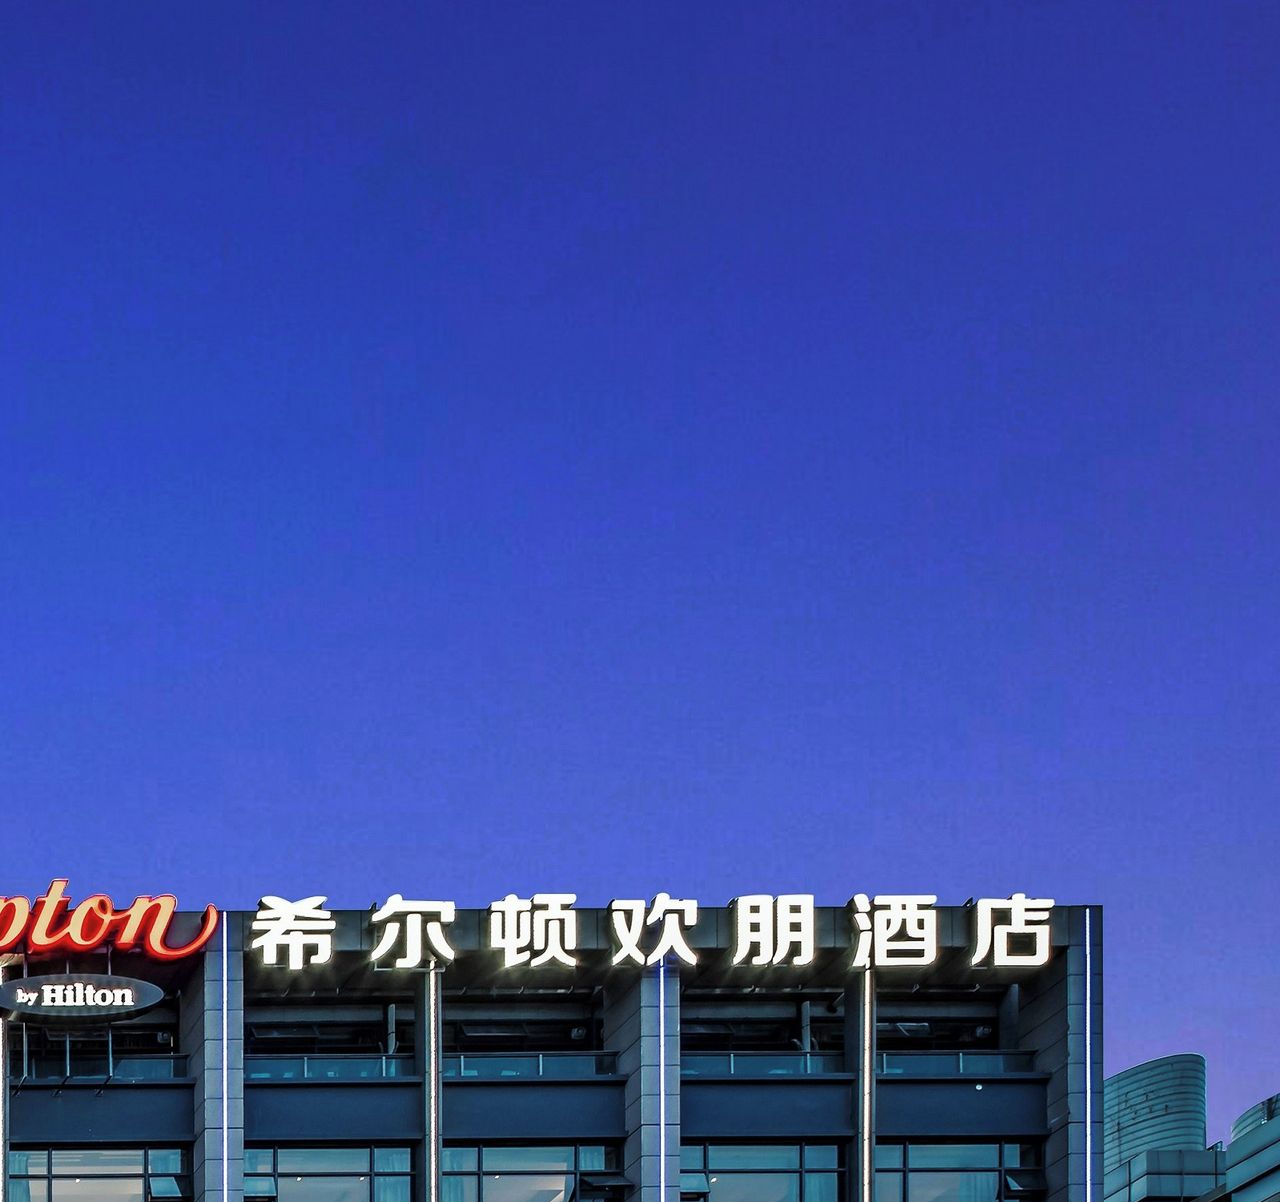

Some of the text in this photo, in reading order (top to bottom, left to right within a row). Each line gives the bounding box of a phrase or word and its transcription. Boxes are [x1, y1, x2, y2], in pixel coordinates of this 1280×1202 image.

[250, 891, 1056, 970] 希尔顿欢朋酒店
[16, 982, 135, 1006] by Hilton
